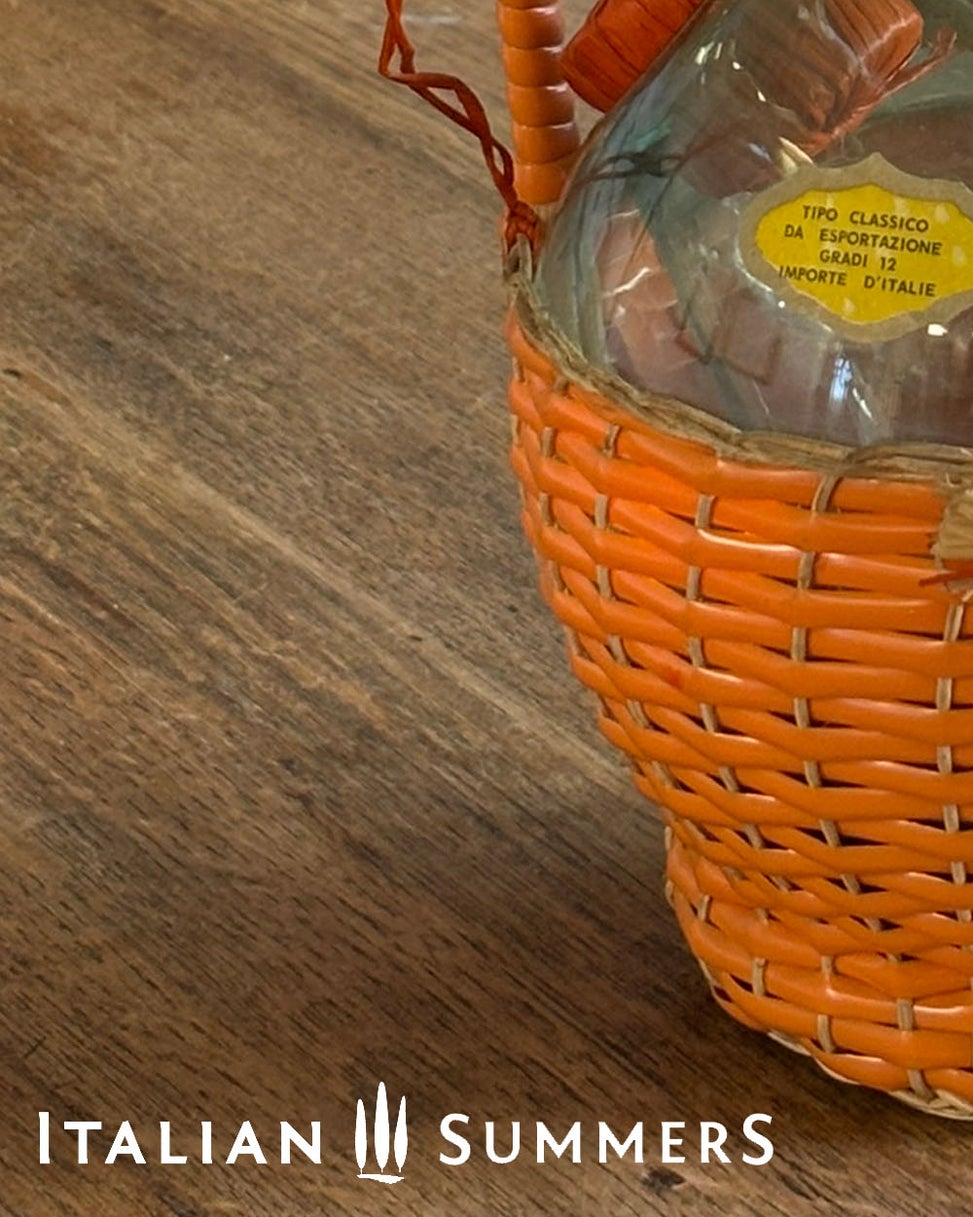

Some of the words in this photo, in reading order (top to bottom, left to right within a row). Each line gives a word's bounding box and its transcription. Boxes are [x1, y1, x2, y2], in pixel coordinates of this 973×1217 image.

[802, 205, 838, 222] TIPO
[850, 210, 929, 233] CLASSICO
[784, 224, 804, 240] DA
[819, 228, 943, 256] ESPORTAZIONE
[819, 249, 868, 268] GRADI
[880, 257, 897, 272] 12
[778, 266, 847, 286] IMPORTE
[863, 275, 936, 297] D'ITALIE
